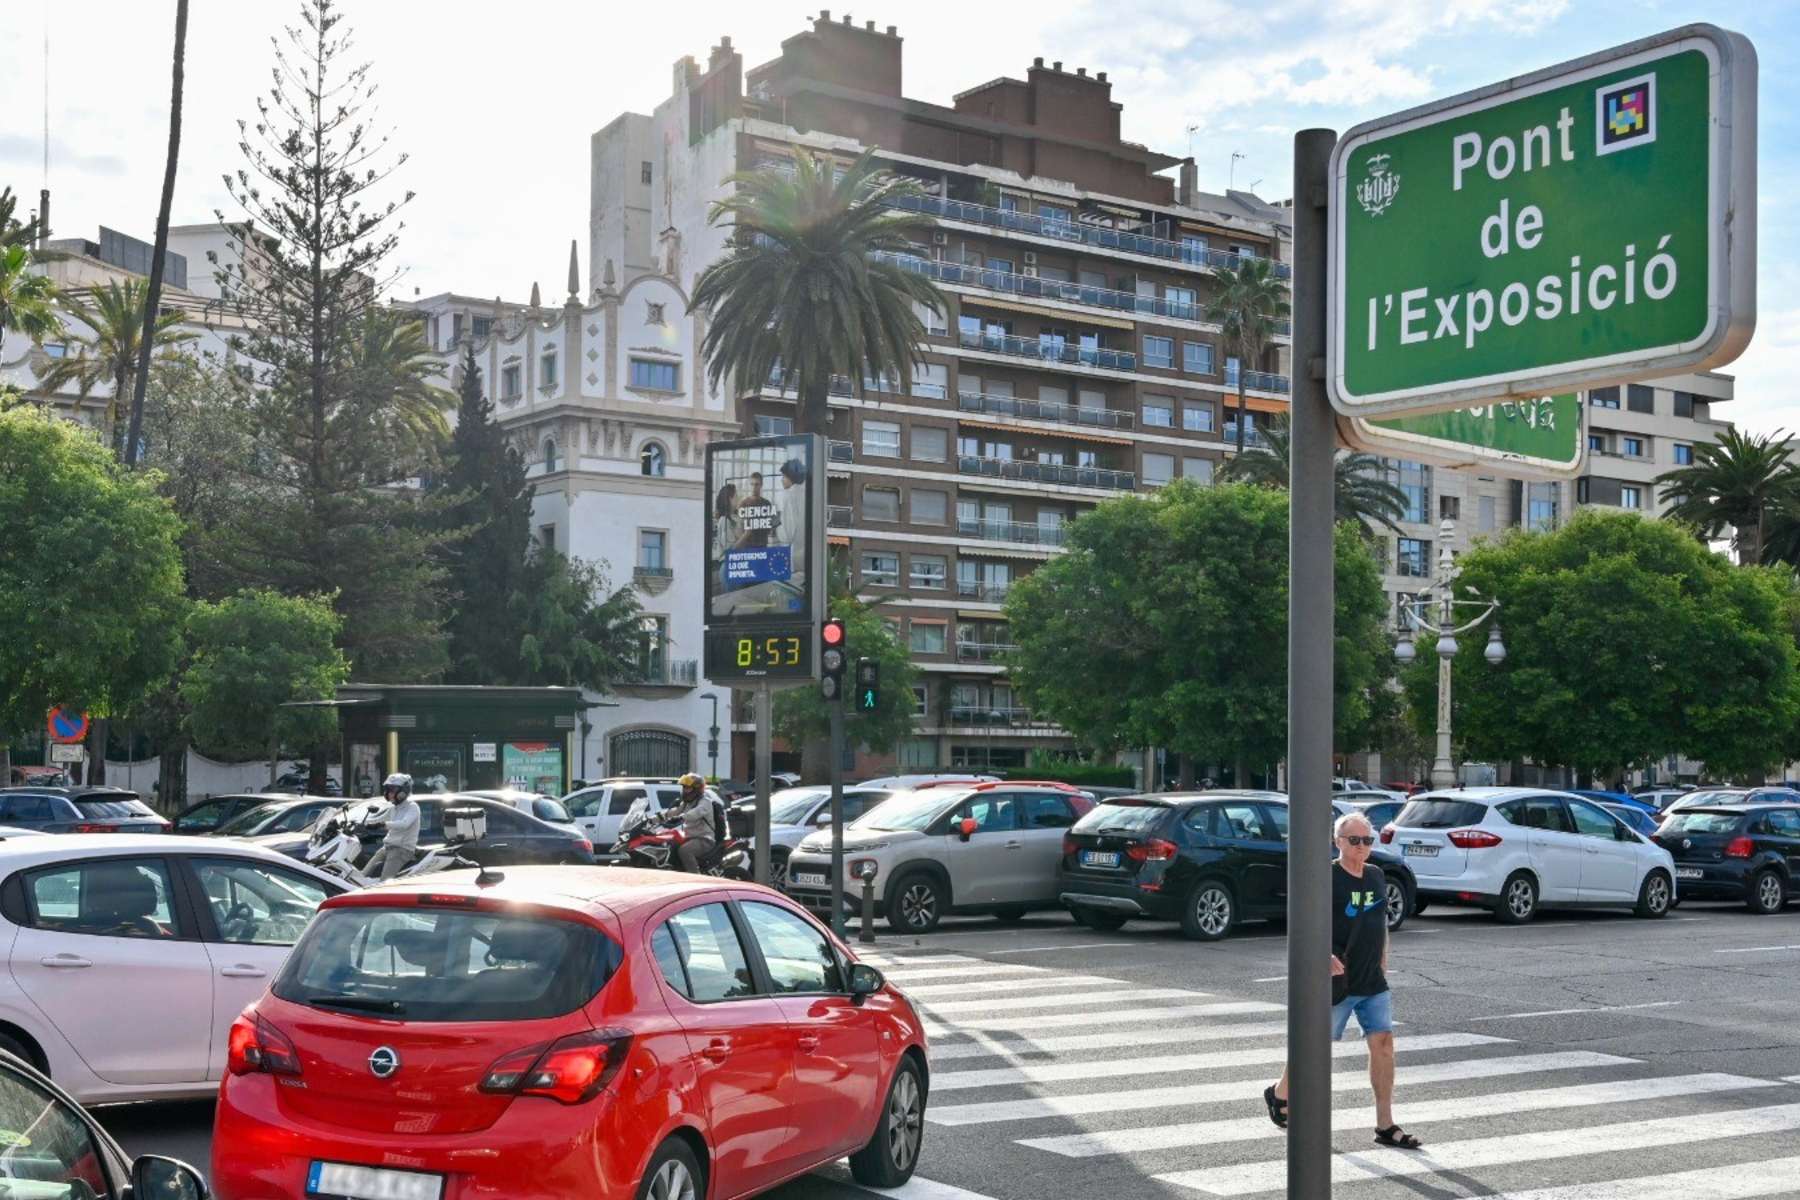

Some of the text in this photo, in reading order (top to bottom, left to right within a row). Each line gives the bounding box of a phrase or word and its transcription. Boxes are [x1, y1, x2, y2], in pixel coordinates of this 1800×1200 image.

[1453, 106, 1574, 191] Pont
[1480, 198, 1544, 258] de
[1368, 234, 1677, 350] l'Exposició
[738, 505, 777, 518] CIENCIA
[744, 518, 772, 530] LIBRE
[737, 638, 799, 666] 8:53
[1351, 891, 1374, 906] NE
